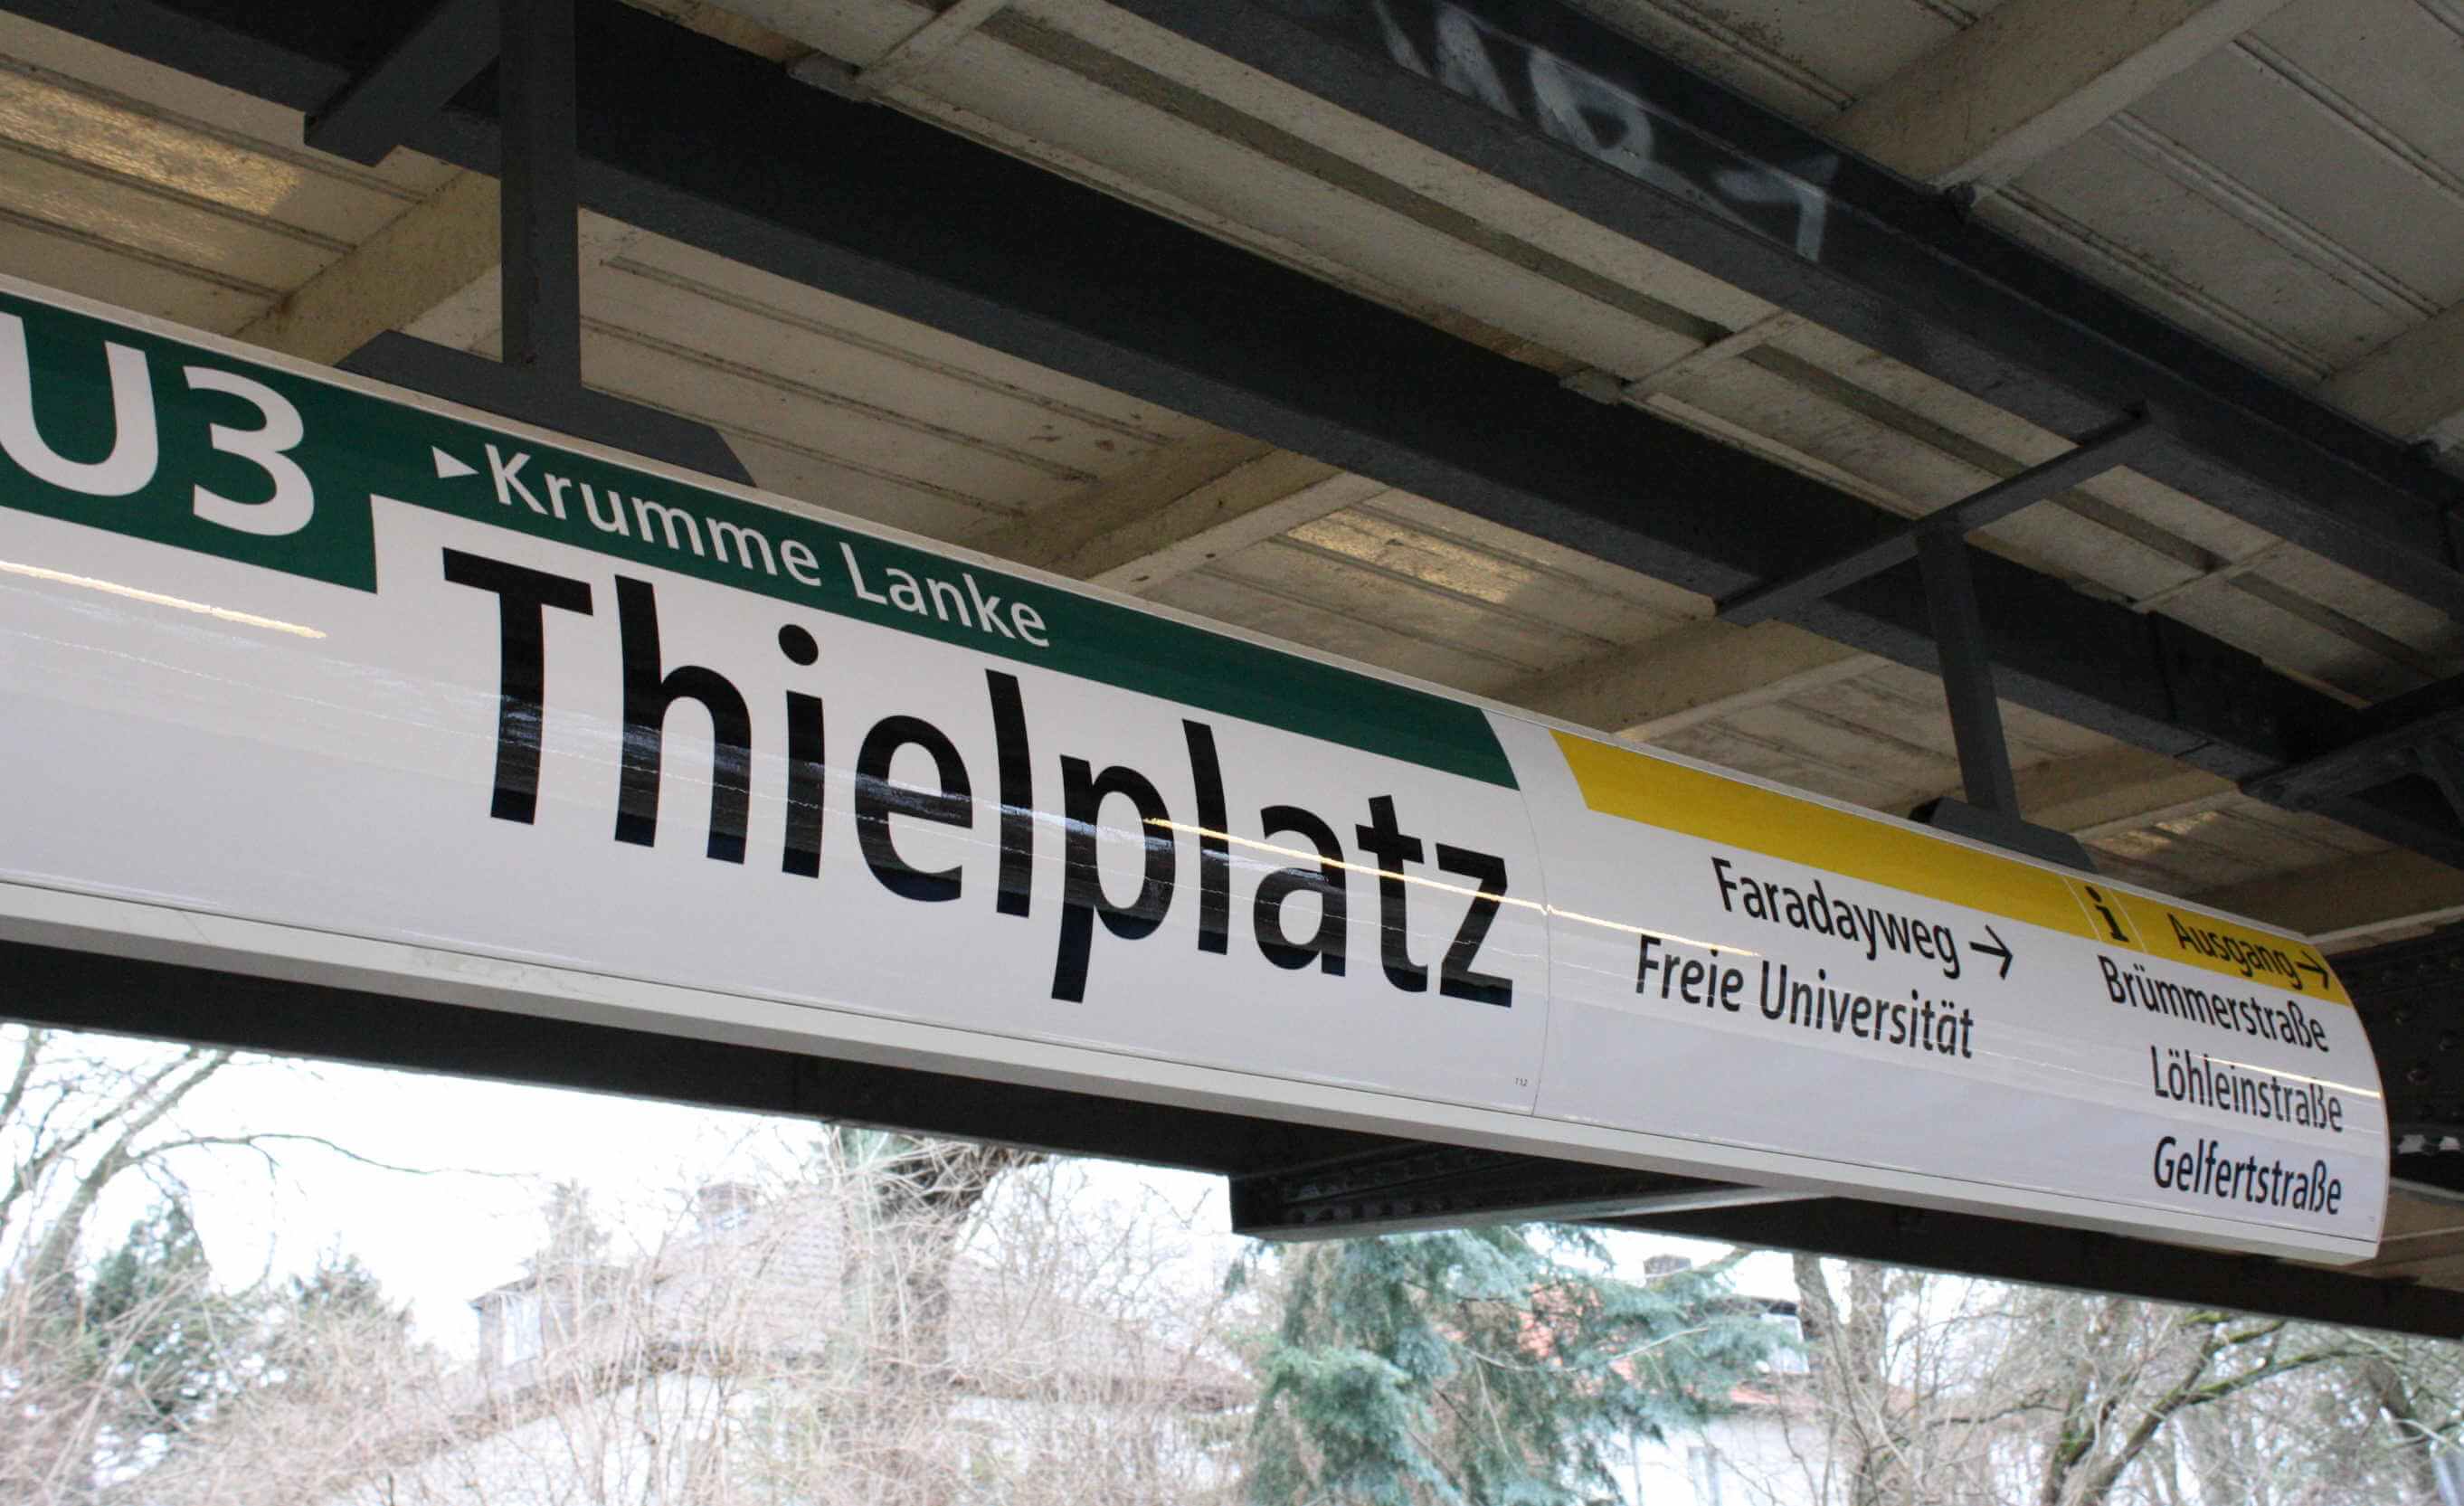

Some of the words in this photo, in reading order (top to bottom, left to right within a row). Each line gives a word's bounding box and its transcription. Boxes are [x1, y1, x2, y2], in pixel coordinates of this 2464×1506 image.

[0, 311, 315, 536] U3
[485, 444, 823, 588] Krumme
[839, 543, 1050, 649] Lanke
[442, 547, 1512, 1004] Thielplatz
[1711, 857, 1961, 980] Faradayweg
[2168, 914, 2303, 990] Ausgang
[1635, 934, 1744, 1012] Freie
[1759, 961, 1974, 1059] Universität
[2098, 955, 2329, 1052] Brümmerstraße
[2150, 1046, 2344, 1132] Löhleinstraße
[2154, 1136, 2343, 1216] Gelfertstraße
